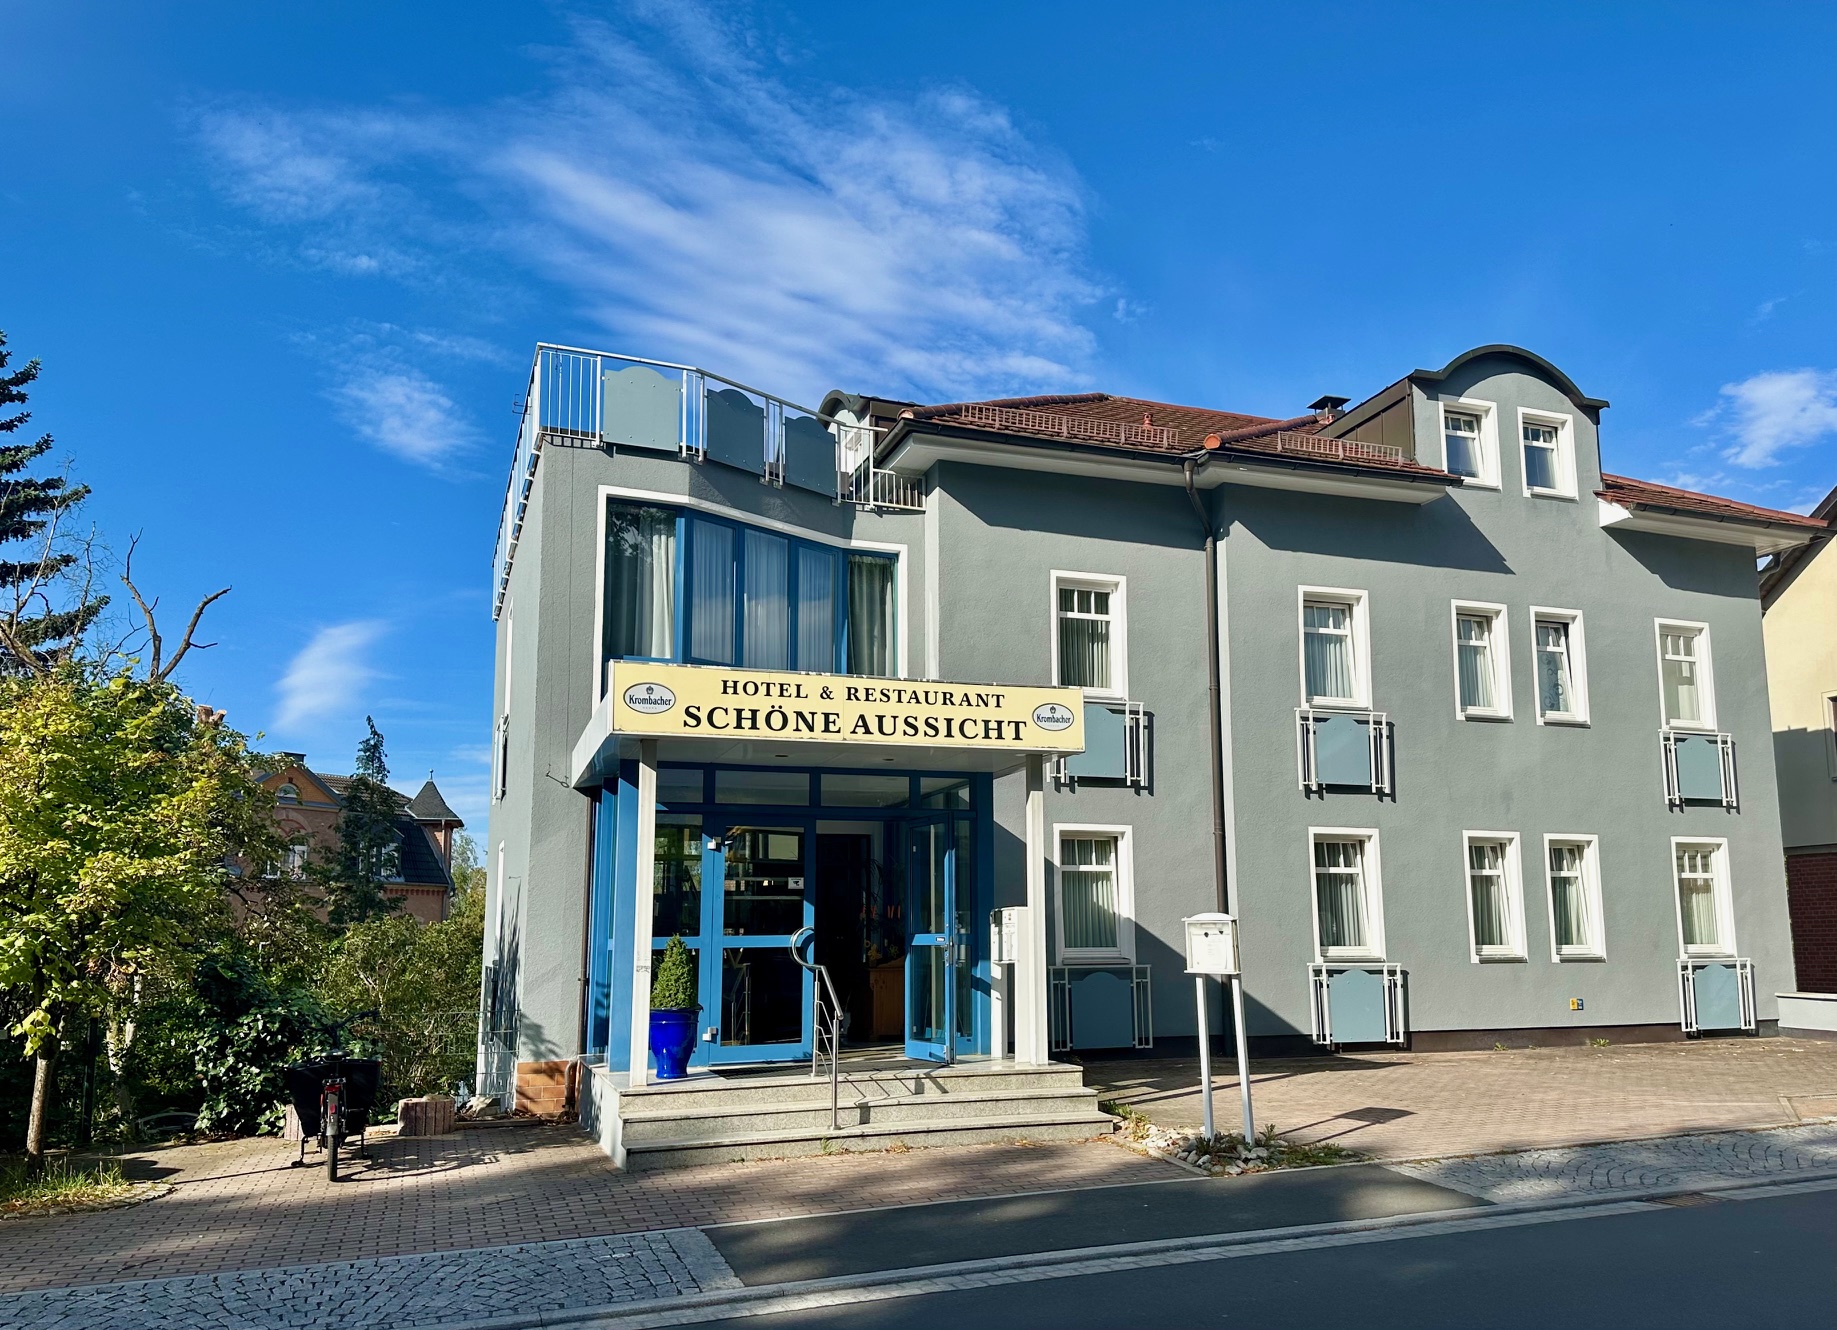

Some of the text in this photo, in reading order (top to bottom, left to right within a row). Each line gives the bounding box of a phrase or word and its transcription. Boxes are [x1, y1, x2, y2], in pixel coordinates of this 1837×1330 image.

[628, 694, 672, 706] Krombacher
[721, 679, 1006, 709] HOTEL & RESTAURANT
[683, 704, 1028, 741] SCHÖNE AUSSICHT
[1036, 713, 1071, 724] Krombacher
